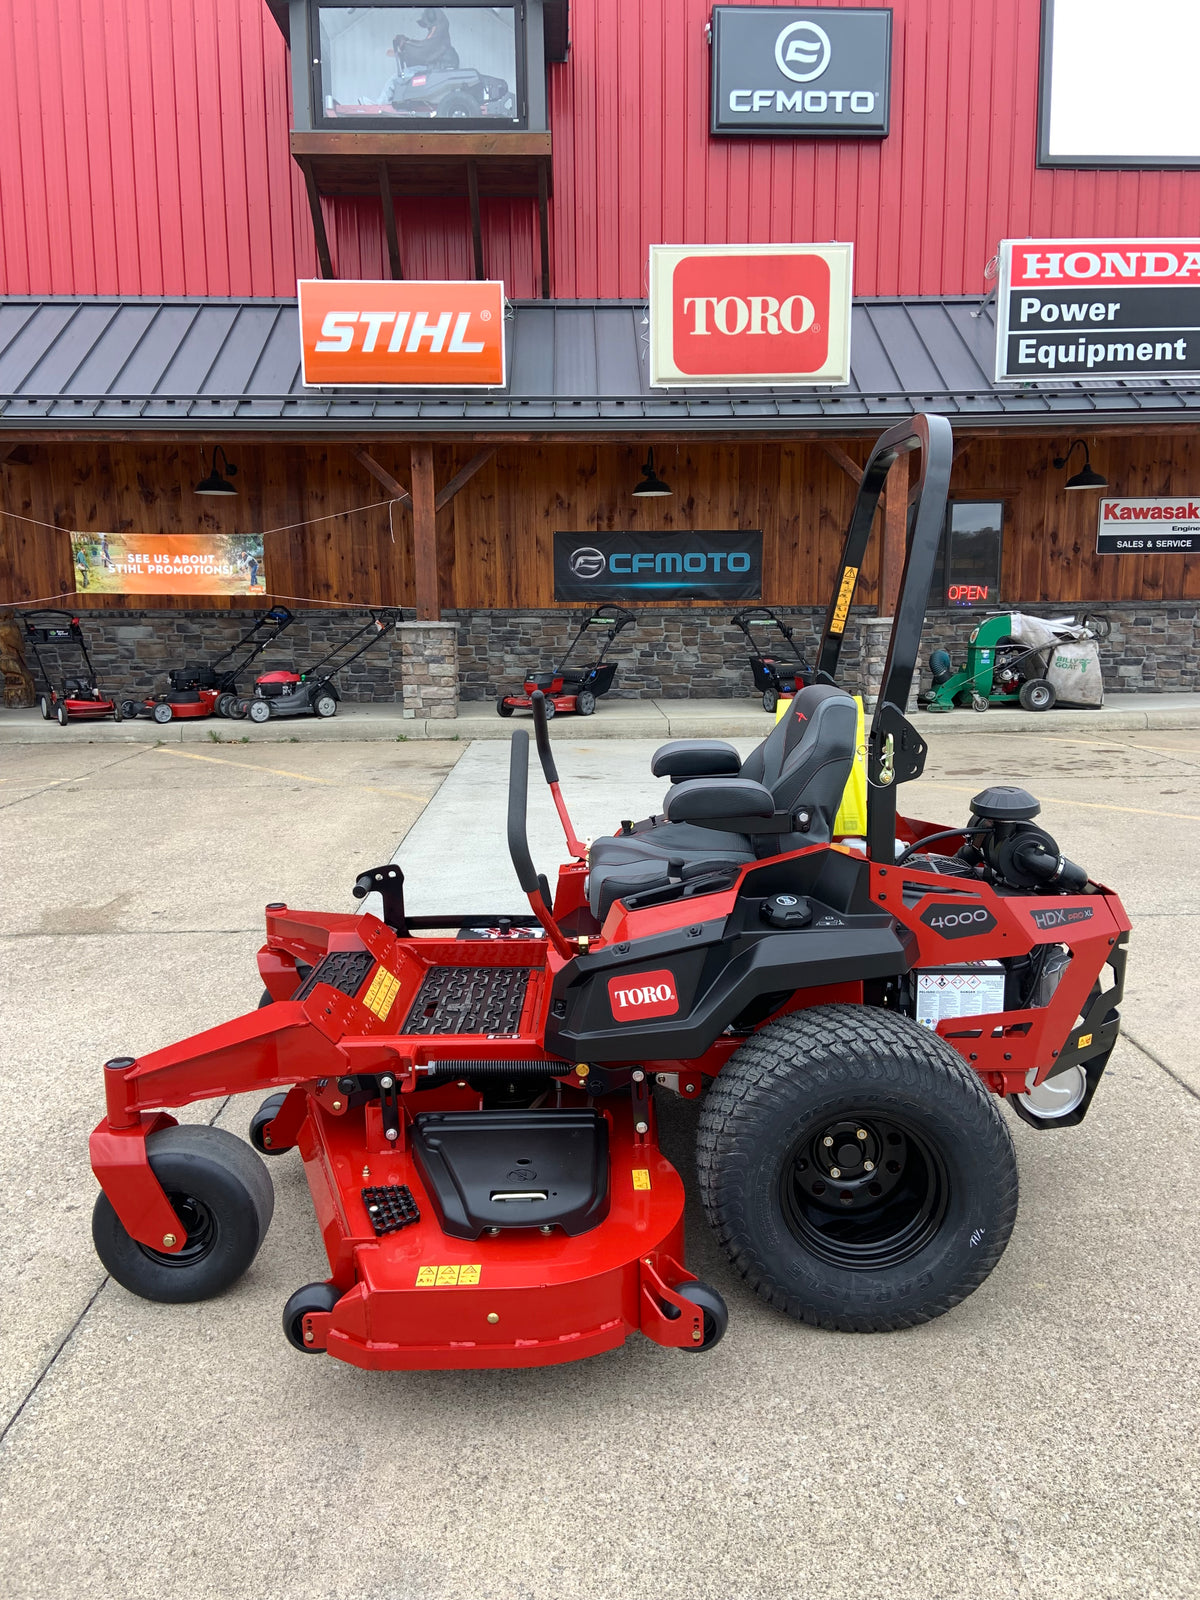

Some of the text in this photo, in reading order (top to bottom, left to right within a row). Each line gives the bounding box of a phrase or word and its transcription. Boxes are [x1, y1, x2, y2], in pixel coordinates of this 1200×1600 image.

[729, 89, 875, 113] CFMOTO
[1022, 252, 1200, 279] HONDA
[684, 295, 816, 335] TORO
[1020, 298, 1121, 322] Power
[314, 311, 485, 353] STIHL
[1018, 338, 1187, 369] Equipment
[1116, 539, 1192, 548] SALES & SERVICE
[127, 553, 215, 564] SEE US ABOUT
[609, 552, 751, 573] CFMOTO
[108, 564, 233, 575] STIHL PROMOTIONS!
[948, 585, 988, 600] OPEN
[1056, 655, 1080, 664] BILLY
[930, 909, 988, 928] 4000
[1035, 909, 1094, 927] HDX PRO XL
[614, 984, 672, 1008] TORO
